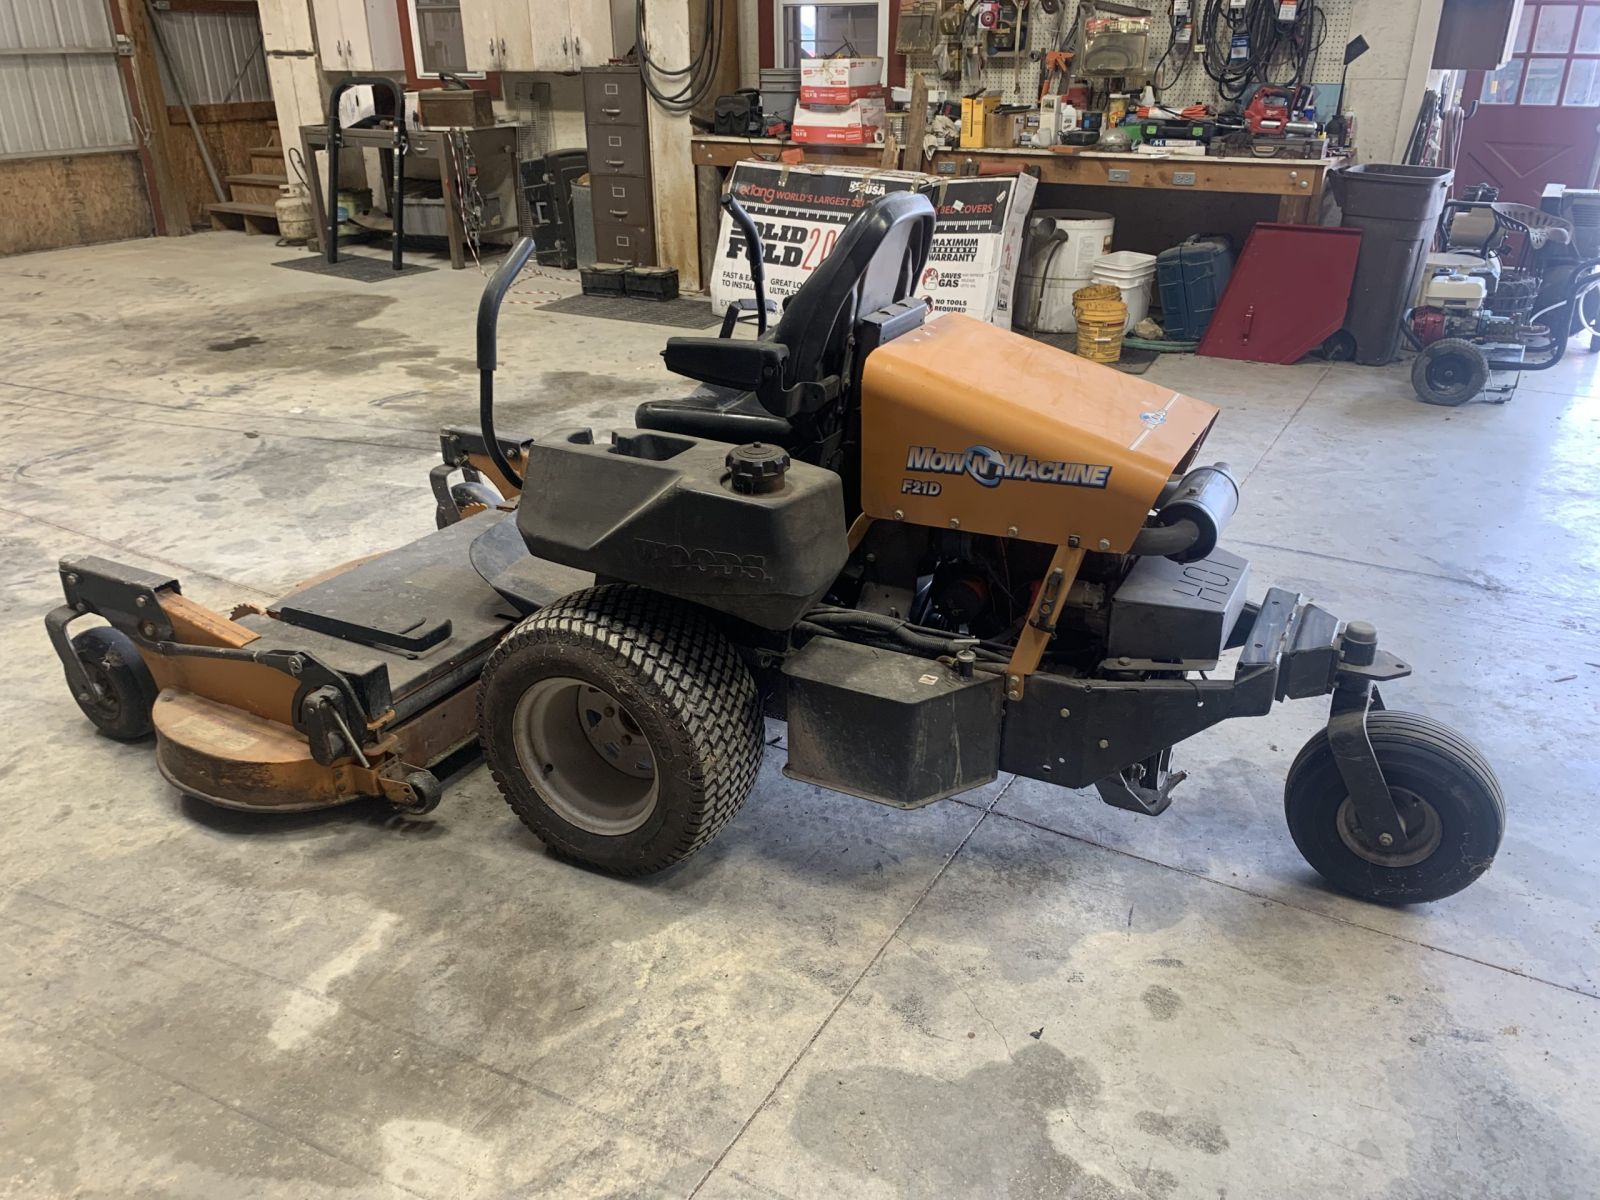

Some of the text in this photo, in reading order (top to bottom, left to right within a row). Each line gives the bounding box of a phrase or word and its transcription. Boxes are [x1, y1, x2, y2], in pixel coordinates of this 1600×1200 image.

[864, 184, 886, 196] USA
[776, 190, 814, 203] WORLD'S
[813, 194, 850, 206] LARGEST
[931, 237, 979, 247] MAXIMUM
[726, 236, 804, 267] FLD
[928, 253, 976, 263] WARRANTY
[722, 270, 739, 279] FAST
[940, 272, 962, 280] SAVES
[721, 279, 755, 291] TO INSTAL
[770, 278, 804, 289] GREAT LO
[938, 279, 959, 288] GAS
[769, 286, 790, 296] ULTRA
[934, 305, 967, 313] REQUIRED
[995, 451, 1112, 489] MACHINE
[901, 479, 942, 497] F21D
